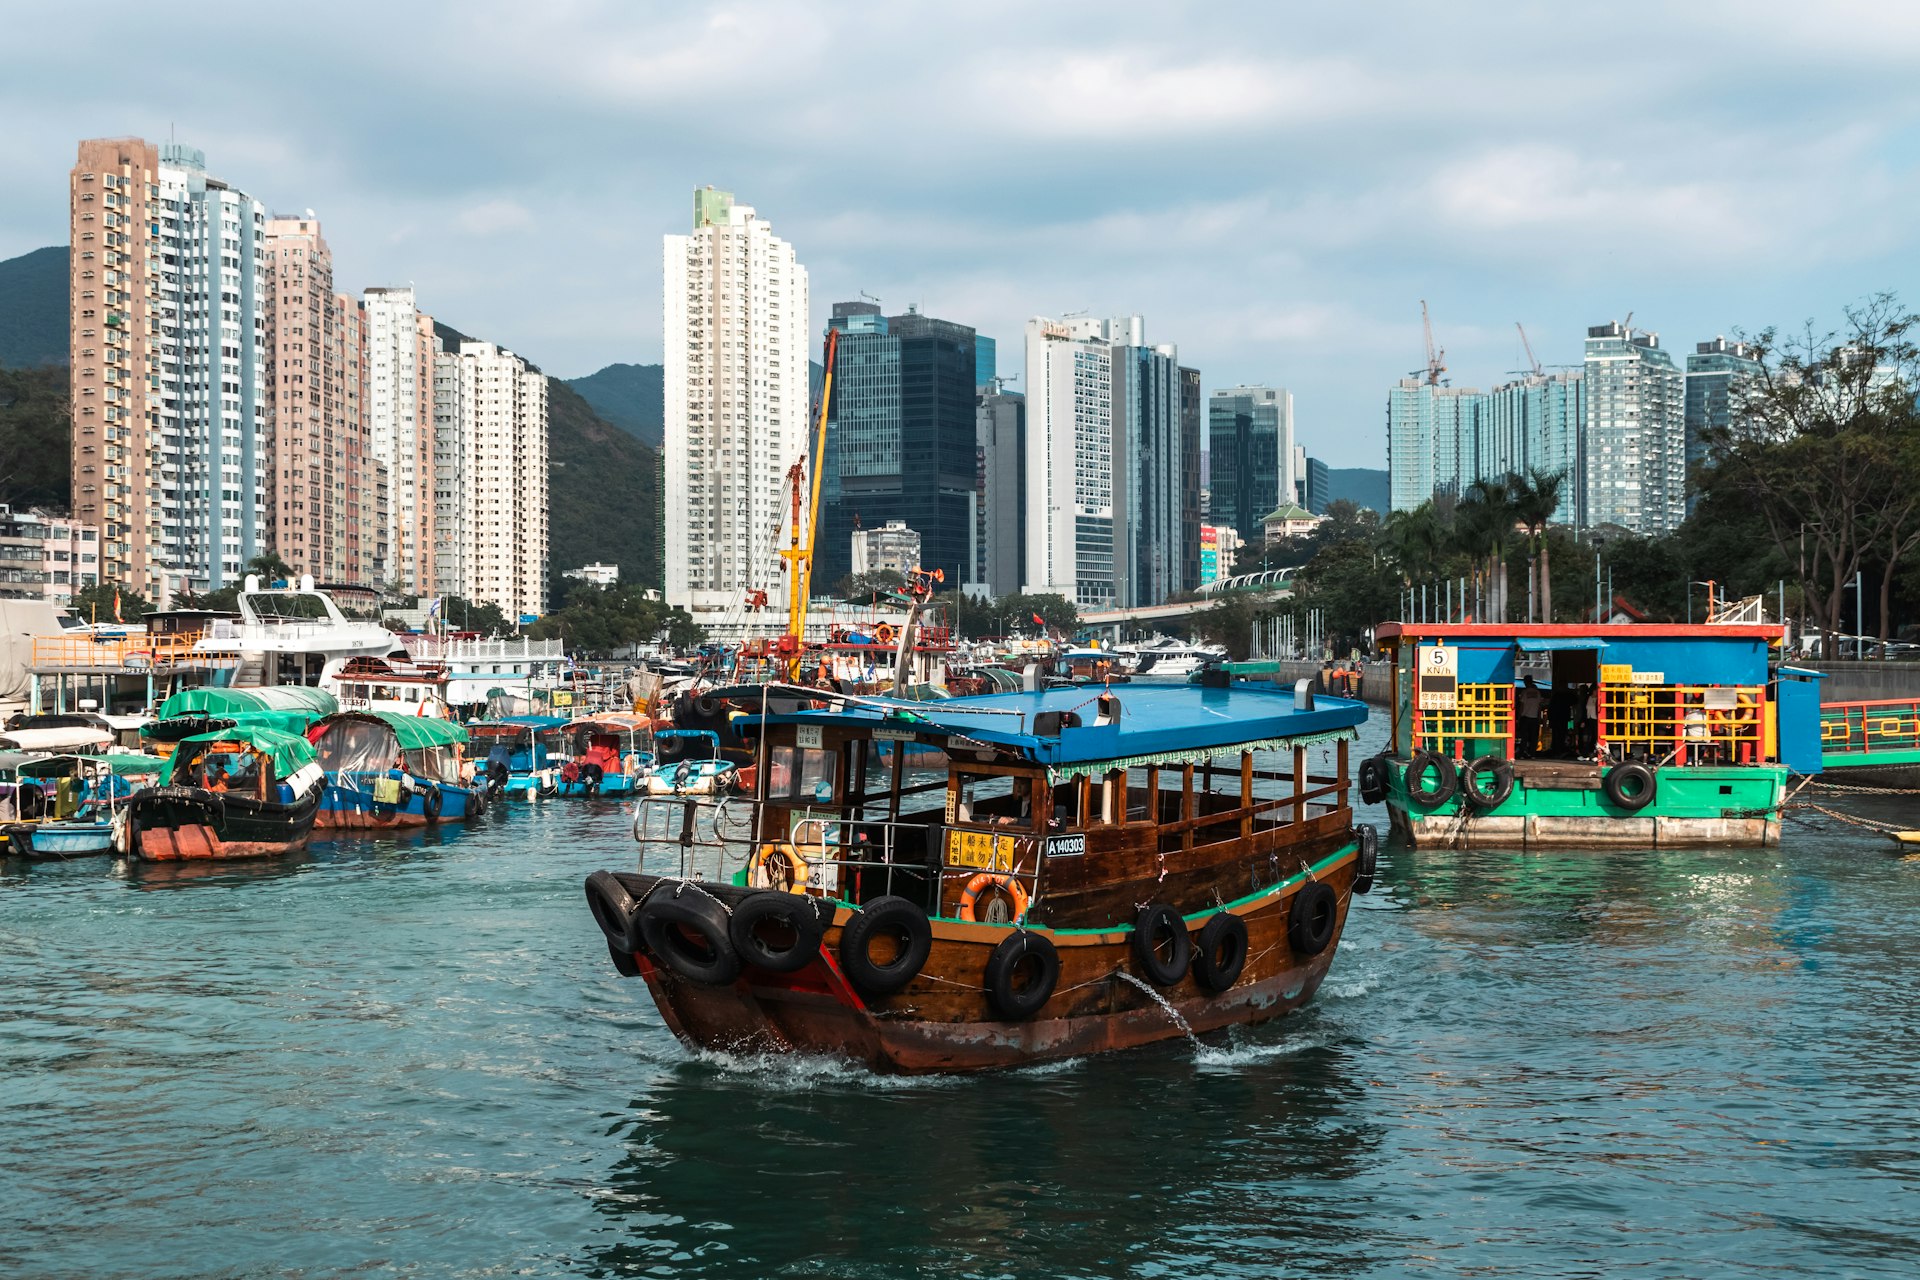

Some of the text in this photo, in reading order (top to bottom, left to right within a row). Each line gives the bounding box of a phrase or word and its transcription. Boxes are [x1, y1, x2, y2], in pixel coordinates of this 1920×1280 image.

[1434, 651, 1443, 664] 5
[1426, 666, 1451, 674] KN/h
[1048, 838, 1084, 854] A140303
